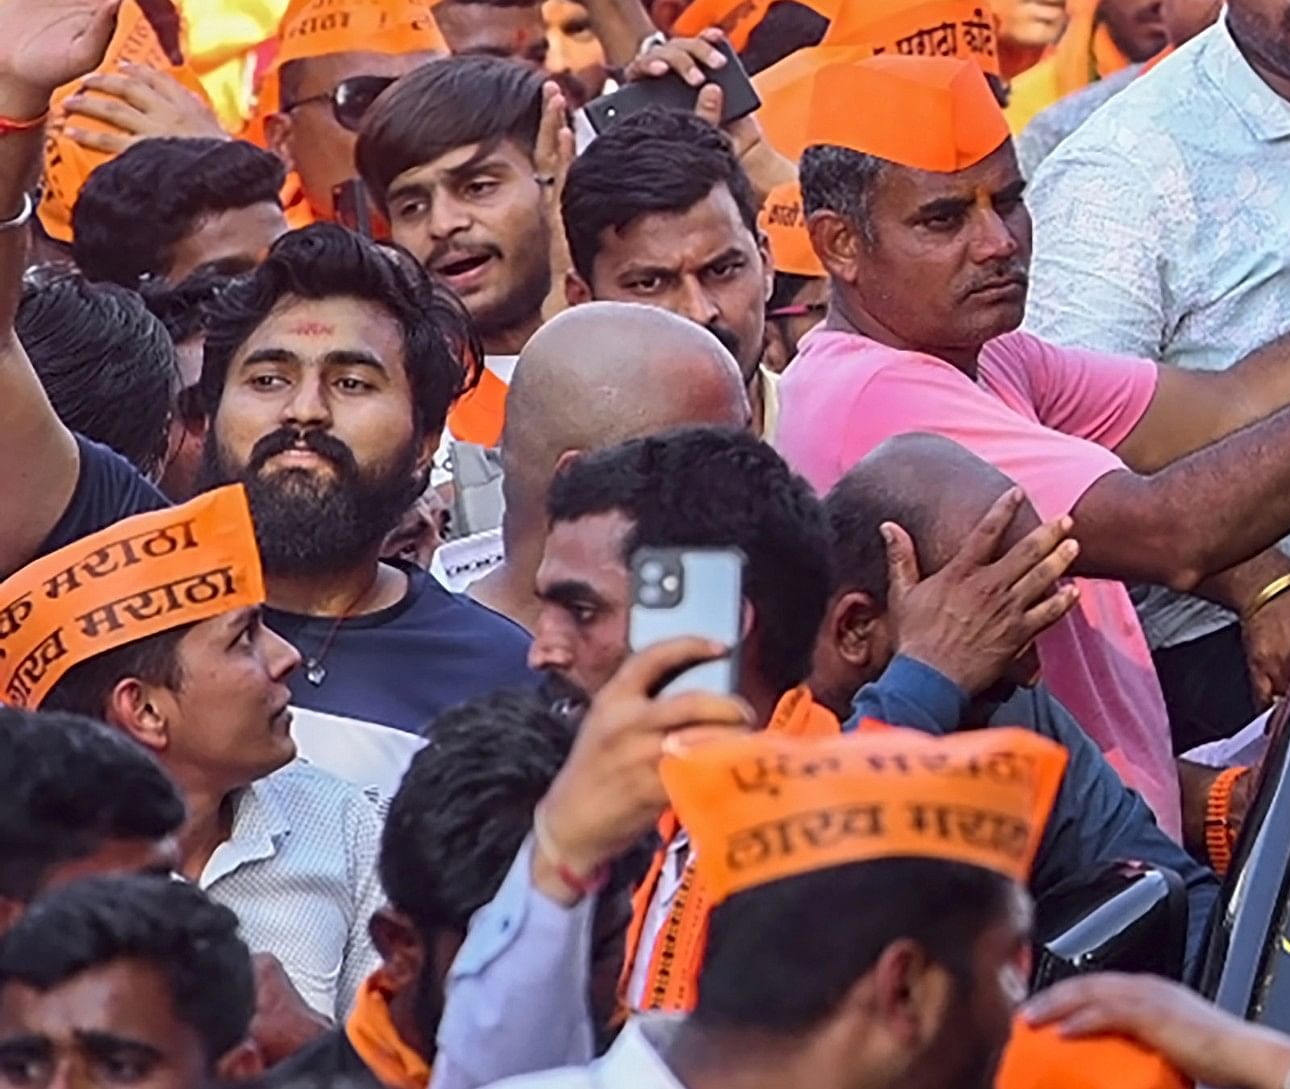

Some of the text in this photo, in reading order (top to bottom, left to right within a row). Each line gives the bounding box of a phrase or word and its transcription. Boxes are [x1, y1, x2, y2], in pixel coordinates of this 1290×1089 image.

[42, 517, 200, 600] मराठा
[74, 566, 238, 638] मराठा
[724, 803, 886, 874] लाख
